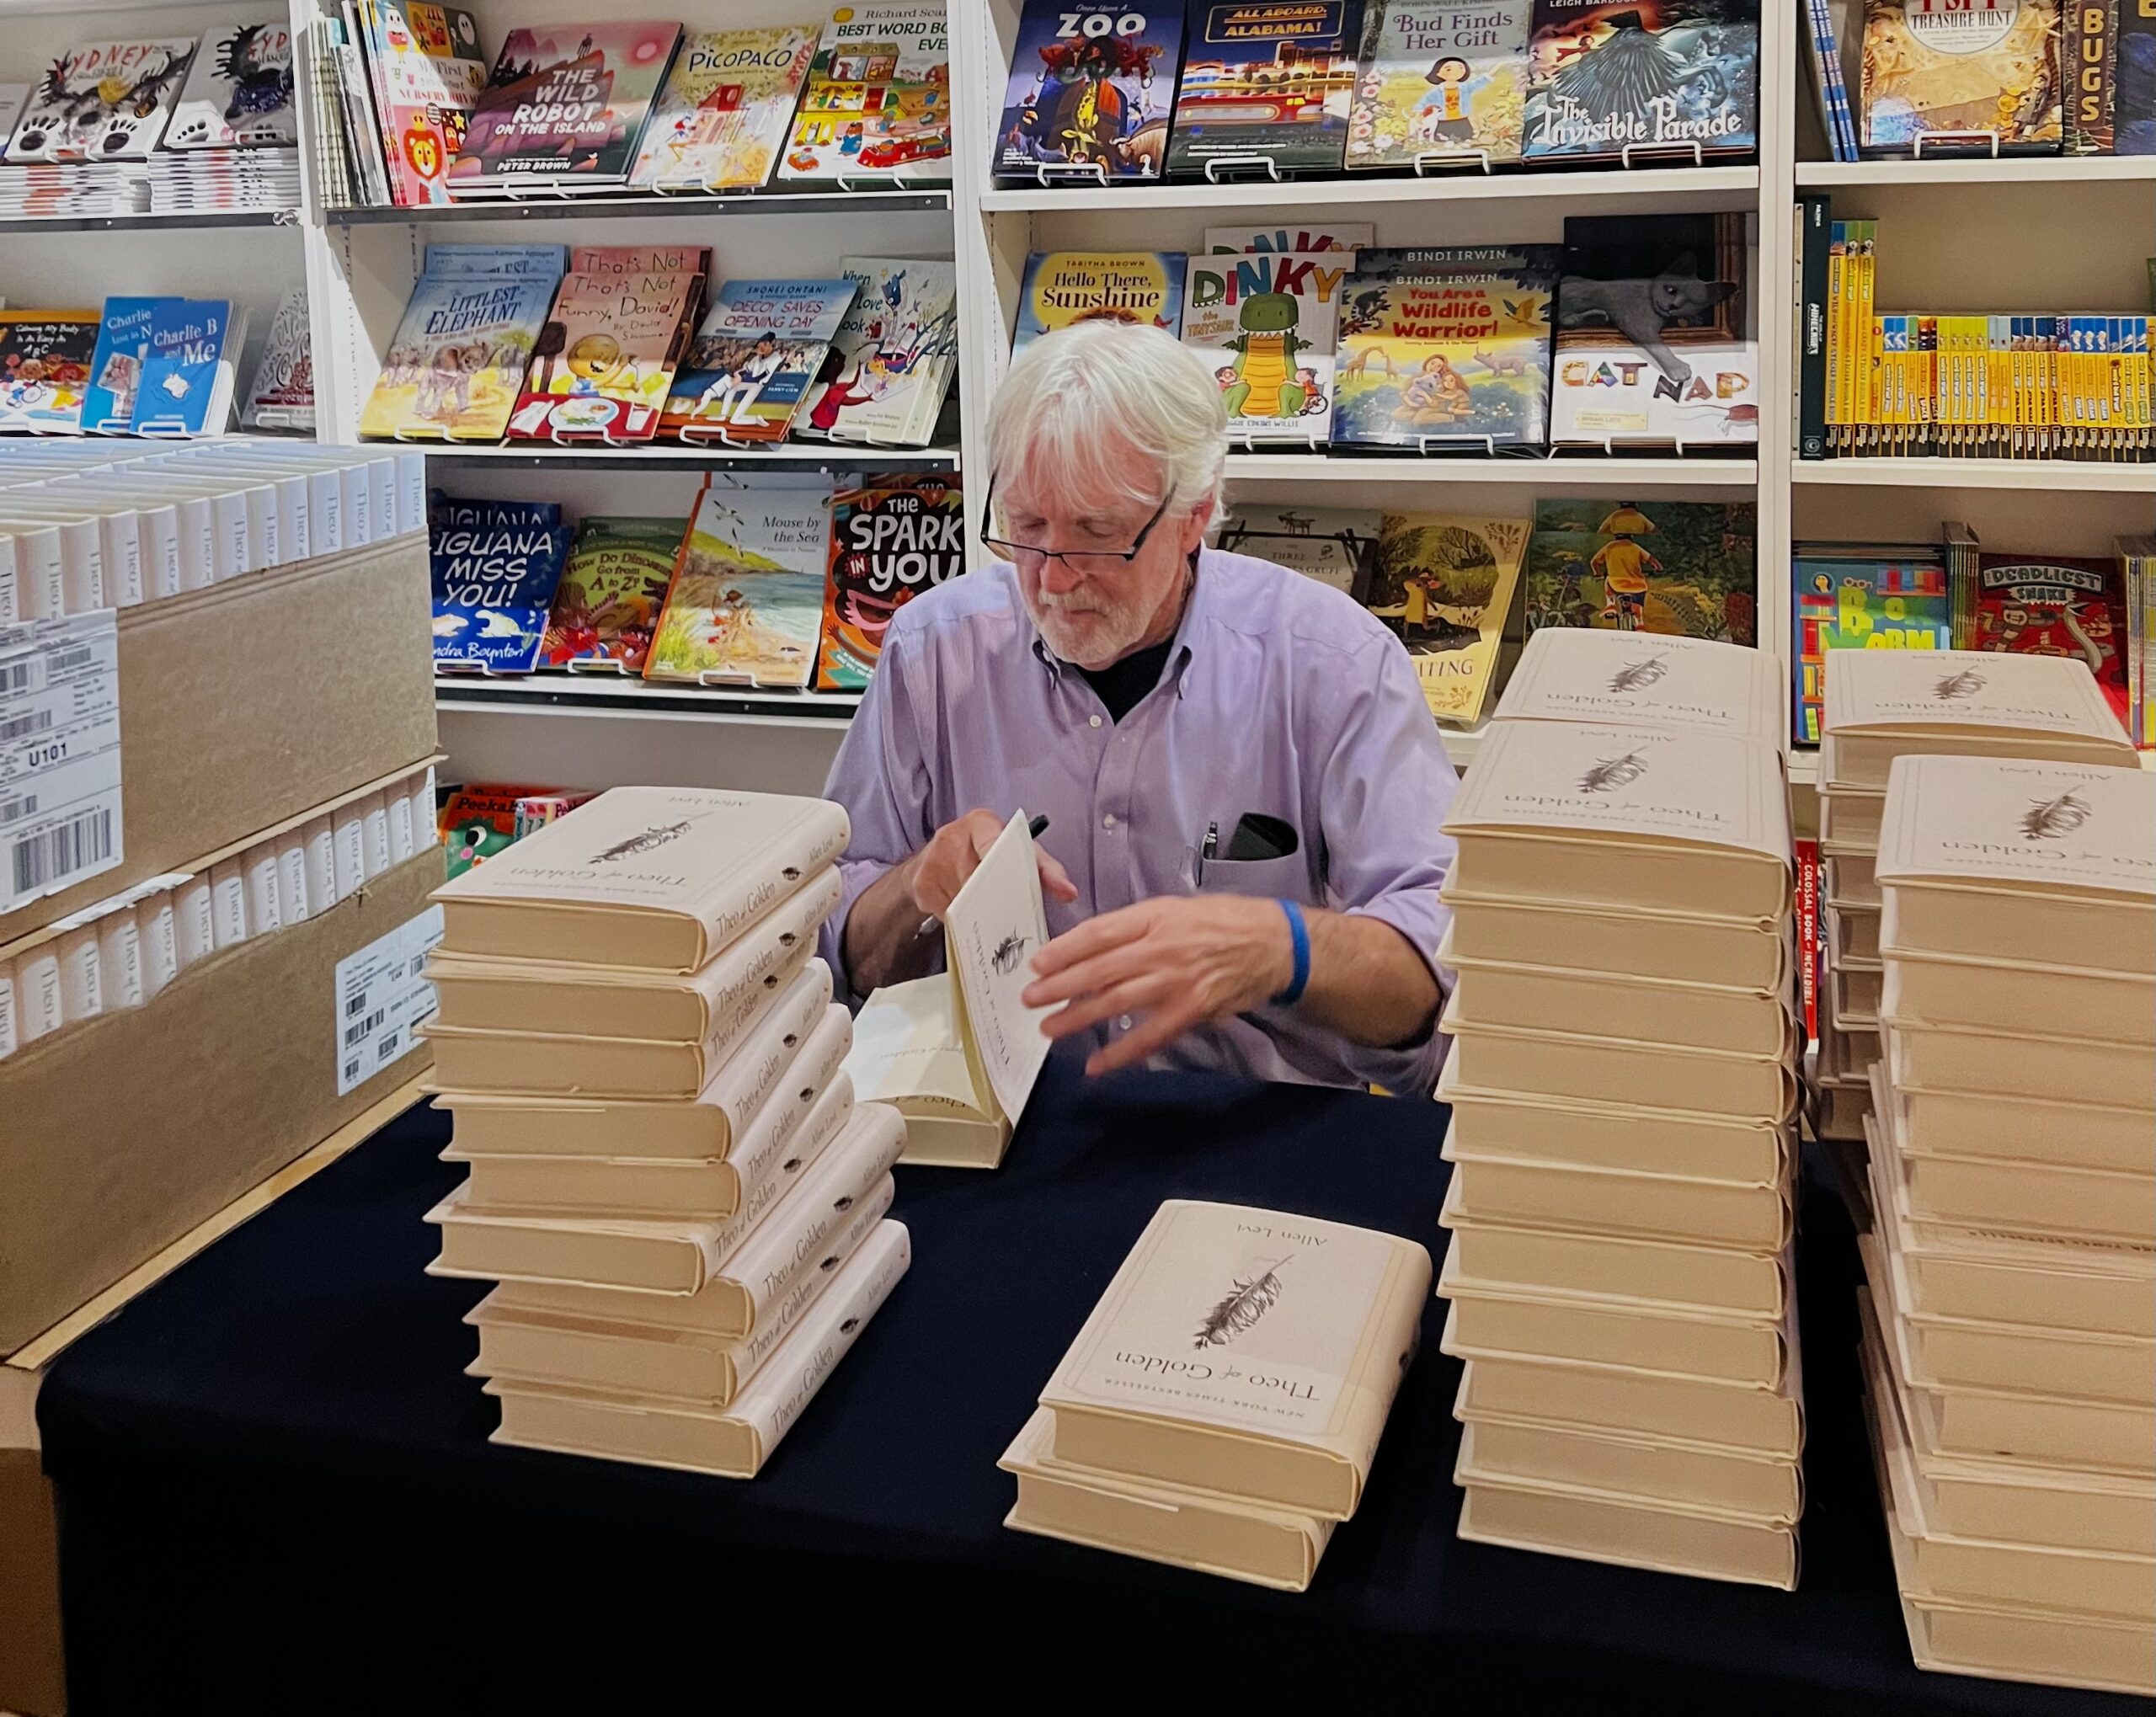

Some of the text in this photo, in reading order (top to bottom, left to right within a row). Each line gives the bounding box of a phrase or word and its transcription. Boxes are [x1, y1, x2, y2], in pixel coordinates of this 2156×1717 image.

[865, 8, 947, 19] Richard Sca
[1232, 9, 1261, 19] ALL
[1393, 11, 1513, 32] Bud Finds
[1911, 10, 2012, 29] TREASURE HUNT
[837, 23, 927, 37] BEST WORD
[1056, 13, 1147, 39] ZOO
[1225, 22, 1322, 37] ALABAMA!
[918, 39, 947, 51] EVE
[1406, 29, 1498, 50] Her Gift
[2080, 8, 2105, 122] BUGS
[552, 69, 596, 85] THE
[536, 83, 599, 103] WILD
[512, 102, 603, 124] ROBOT
[1557, 95, 1589, 121] The
[494, 121, 606, 136] ON THE ISLAND
[1532, 97, 1742, 147] Invisible Parade
[497, 161, 571, 172] PETER BROWN
[654, 253, 686, 272] Not
[1066, 259, 1145, 269] TABITHA BROWN
[1407, 249, 1506, 262] BINDI IRWIN
[643, 276, 676, 292] Not
[842, 269, 871, 285] When
[1054, 273, 1152, 289] Hello There,
[1193, 257, 1347, 308] DINKY
[1396, 273, 1497, 285] BINDI IRWIN
[449, 285, 520, 313] LITTLEST
[857, 297, 883, 311] Love
[1042, 286, 1160, 308] Sunshine
[1409, 288, 1439, 299] You
[424, 301, 522, 334] ELEPHANT
[558, 296, 680, 323] Funny, David!
[731, 300, 825, 314] DECOY SAVES
[1203, 311, 1219, 322] the
[1401, 301, 1492, 318] Wildlife
[107, 310, 152, 330] Charlie
[724, 316, 818, 328] OPENING DAY
[841, 319, 865, 333] ook
[1187, 318, 1235, 338] TINYSAUR
[1393, 320, 1498, 338] Warrior!
[1807, 302, 1820, 355] MINECRAFT
[153, 324, 202, 347] Charlie
[206, 318, 218, 336] B
[182, 342, 216, 367] Me
[1561, 360, 1648, 388] CAT
[1652, 371, 1750, 403] NAP
[328, 497, 338, 534] Theo
[357, 493, 367, 530] Theo
[762, 516, 821, 532] Mouse by
[850, 514, 963, 552] SPARK
[434, 531, 552, 556] IGUANA
[774, 531, 820, 543] the Sea
[127, 541, 138, 583] Theo
[600, 553, 617, 563] Do
[851, 557, 866, 573] IN
[445, 558, 526, 581] MISS
[597, 565, 640, 575] Go from
[868, 553, 960, 592] YOU
[590, 576, 605, 590] A
[608, 579, 619, 588] to
[443, 583, 517, 607] YOU!
[433, 642, 524, 659] ndra Boynton
[1547, 693, 1733, 720] Theo Golden
[29, 743, 67, 767] U101
[1505, 795, 1730, 823] Theo Golden
[1942, 842, 2068, 860] Golden
[510, 867, 686, 886] Theo Golden
[1804, 864, 1813, 910] COLOSSAL
[716, 882, 776, 936] Theo Golden
[1804, 915, 1812, 941] BOOK
[746, 950, 774, 984] Golden
[716, 1182, 776, 1257] Theo Golden
[1237, 1222, 1328, 1248] Allen Levi
[764, 1220, 828, 1298] Theo Golden
[1116, 1351, 1321, 1402] Theo of Golden
[771, 1346, 835, 1433] Theo Golden
